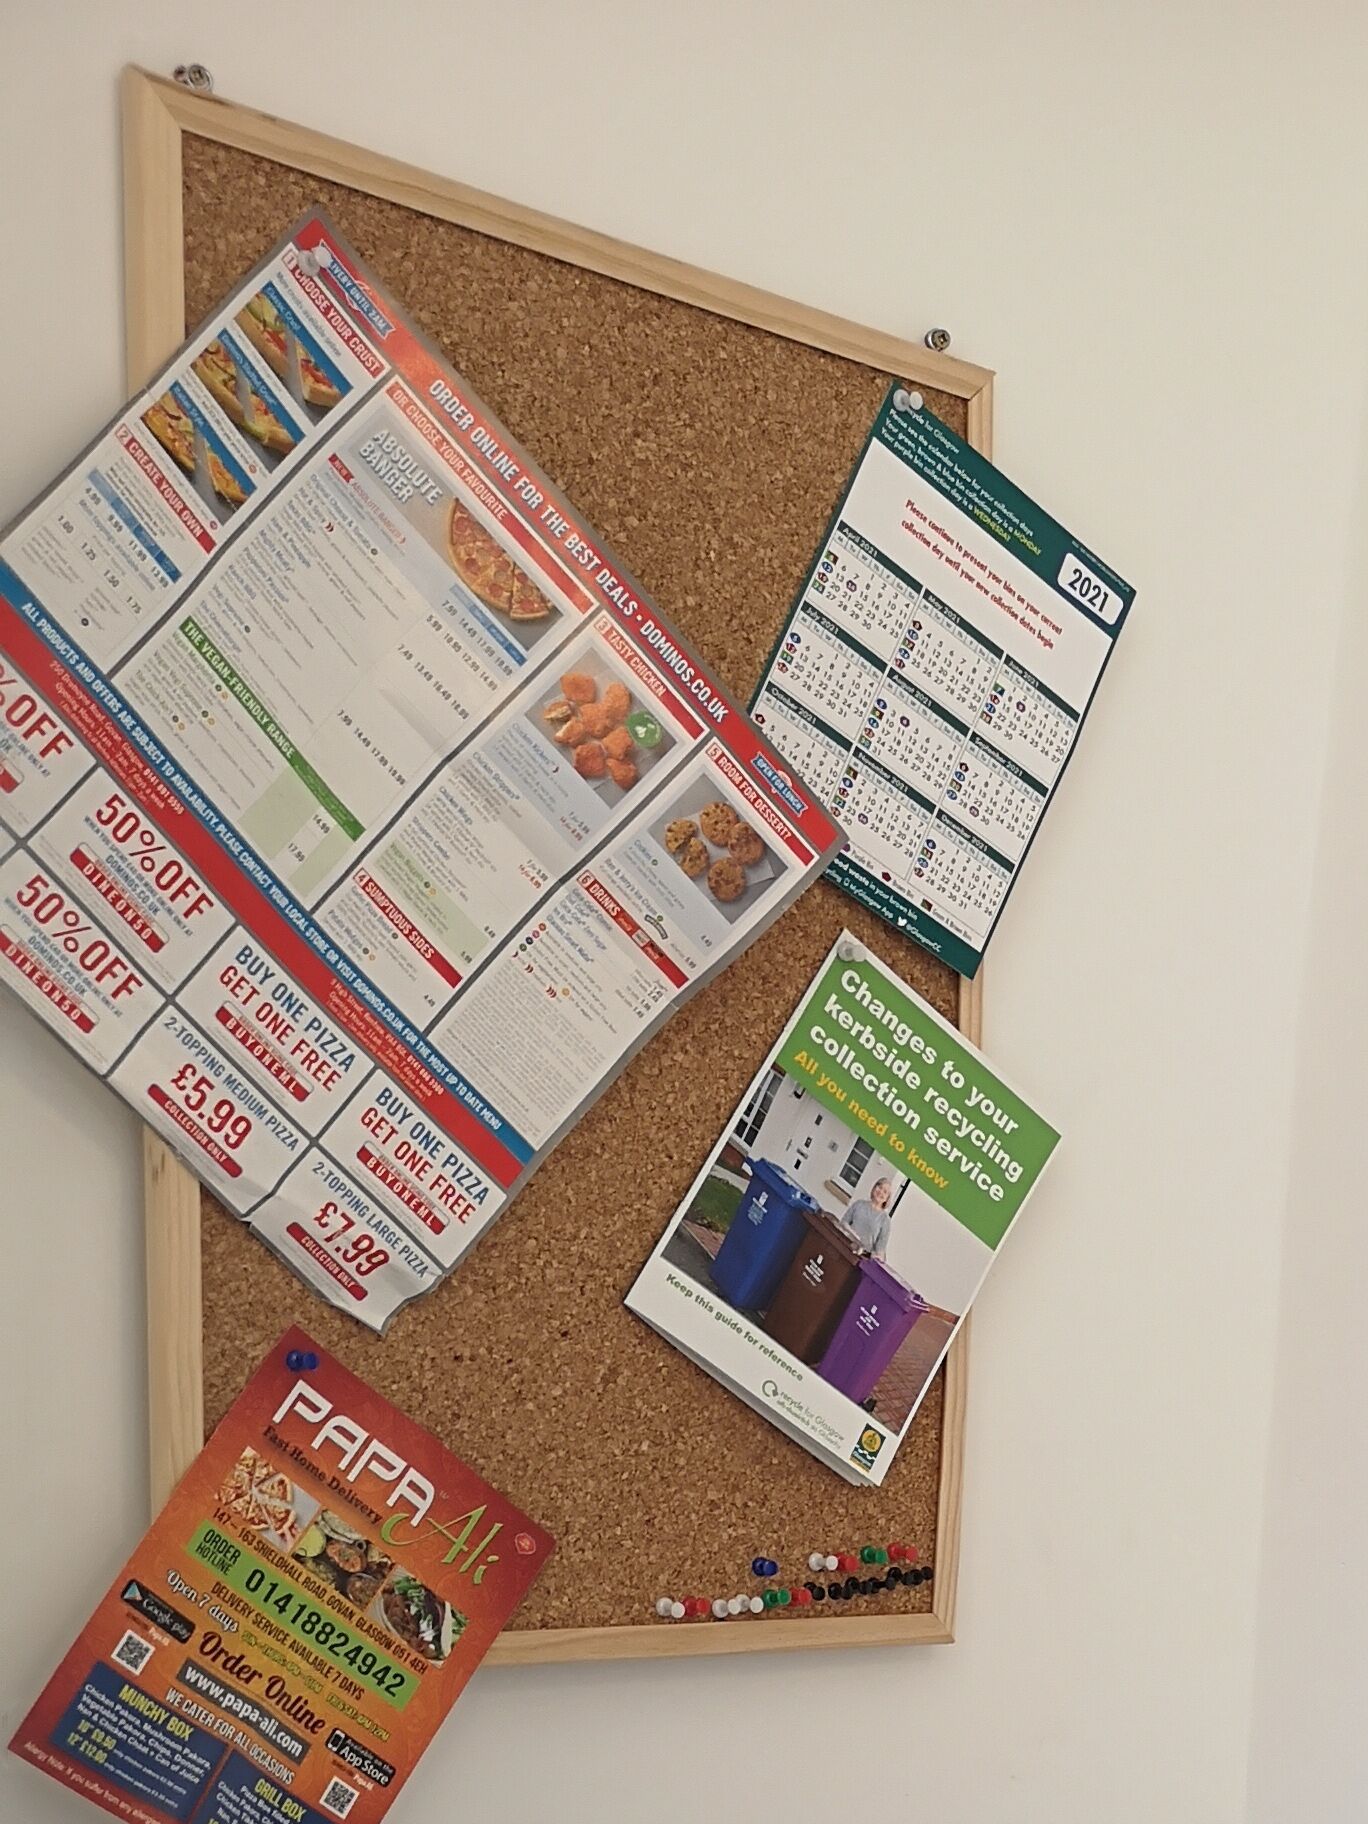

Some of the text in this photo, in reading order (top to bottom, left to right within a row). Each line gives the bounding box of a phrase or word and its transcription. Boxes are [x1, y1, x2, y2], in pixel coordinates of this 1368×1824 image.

[357, 438, 416, 504] BANGER
[371, 424, 444, 506] ABSOLUTE
[427, 377, 729, 724] ORDER ONLINE FOR THE BEST DEALS DOMINOS.CO.UK
[905, 498, 928, 524] Please
[927, 518, 955, 547] continue
[962, 547, 987, 574] present
[986, 568, 1002, 587] your
[1002, 580, 1017, 597] bins
[1024, 600, 1040, 618] your
[1067, 565, 1109, 614] 2021
[182, 621, 298, 759] THE VEGAN-FRIENDLY RANGE
[588, 882, 620, 917] DRINKS
[215, 963, 343, 1092] GET ONE FREE
[232, 944, 359, 1073] BUY ONE PIZZA
[836, 965, 1019, 1144] Changes to your
[161, 1015, 301, 1152] 2-TOPPING MEDIUM PIZZA
[164, 1060, 258, 1151] £5.99
[793, 1047, 949, 1191] All you need to know
[807, 1018, 1007, 1205] collection service
[822, 991, 1026, 1187] kerbside recycling
[356, 1105, 477, 1225] GET ONE FREE
[373, 1086, 492, 1206] BUY ONE PIZZA
[305, 1197, 393, 1283] £7.99
[310, 1160, 430, 1278] 2-TOPPING LARGE PIZZA
[664, 1272, 804, 1383] Keep this guide for reference
[261, 1424, 384, 1527] Fast Home Delivery
[271, 1376, 440, 1532] PAPA
[194, 1542, 233, 1576] HOTLINE
[202, 1527, 242, 1564] ORDER
[211, 1506, 231, 1526] 147
[237, 1527, 257, 1546] 163
[252, 1539, 303, 1582] SHIELDHALL
[300, 1575, 329, 1602] ROAD,
[354, 1615, 395, 1651] GLASGOW
[408, 1655, 428, 1675] 4EH
[381, 1504, 501, 1585] Ali
[138, 1595, 174, 1627] Google
[169, 1618, 193, 1640] play
[160, 1566, 243, 1637] Open 7 days
[210, 1581, 365, 1701] DELIVERY SERVICE AVAILABLE 7 DAYS
[242, 1565, 407, 1699] 01418824942
[117, 1682, 194, 1742] MUNCHY BOX
[163, 1687, 297, 1785] WE CATER FOR ALL OCCASIONS
[181, 1661, 306, 1759] www.papa-ali.com
[194, 1627, 332, 1737] Order Online
[252, 1777, 307, 1823] GRILL BOX
[338, 1744, 364, 1769] App
[360, 1759, 390, 1786] Store
